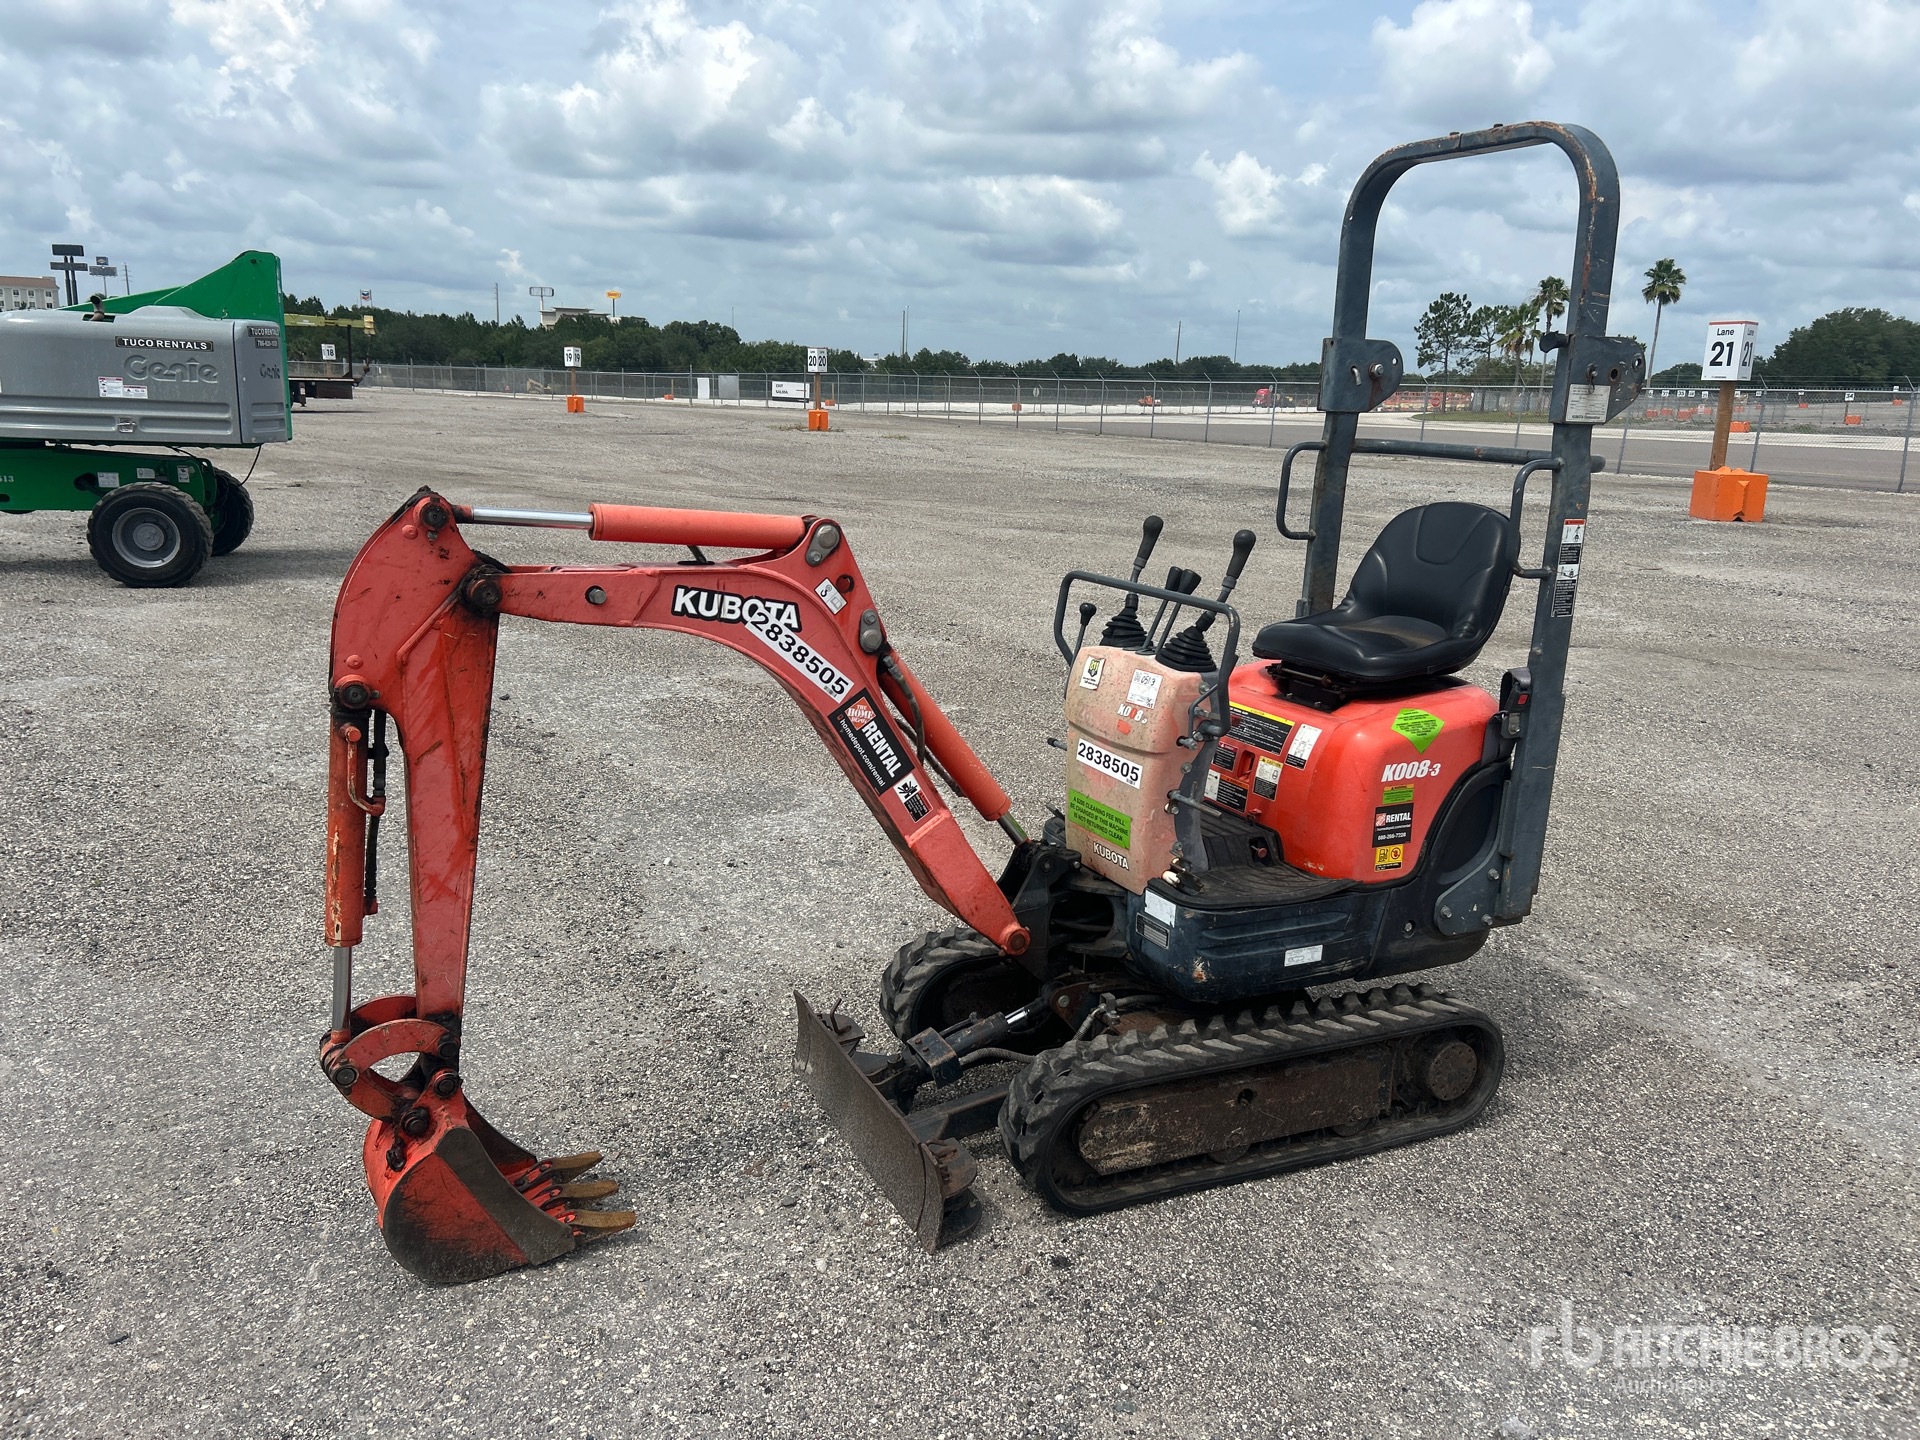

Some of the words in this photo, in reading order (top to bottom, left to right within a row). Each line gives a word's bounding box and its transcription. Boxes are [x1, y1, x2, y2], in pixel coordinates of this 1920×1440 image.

[1716, 328, 1735, 336] Lane
[122, 338, 154, 347] TUCO
[156, 340, 208, 350] RENTALS
[1709, 341, 1734, 366] 21
[1742, 341, 1753, 367] 21
[124, 354, 218, 384] Genie
[566, 353, 572, 362] 19
[575, 353, 580, 362] 19
[808, 356, 816, 366] 20
[818, 356, 826, 366] 20
[260, 363, 280, 380] Genie
[674, 588, 799, 628] KUBOTA
[750, 612, 849, 695] 2838505
[848, 708, 873, 719] HOME
[840, 719, 886, 787] homedepot.com/rental
[862, 720, 902, 778] RENTAL
[1078, 742, 1140, 782] 2838505
[1381, 760, 1441, 782] K008-3
[1076, 805, 1094, 818] CHARGED
[1099, 816, 1108, 826] THIS
[1108, 820, 1128, 836] MACHINE
[1086, 802, 1106, 816] CLEANING
[1106, 811, 1114, 820] FEE
[1115, 816, 1125, 826] WILL
[1386, 812, 1411, 823] RENTAL
[1086, 818, 1107, 833] RETURNED
[1108, 829, 1123, 841] CLEAN
[1093, 842, 1129, 870] KUBOTA
